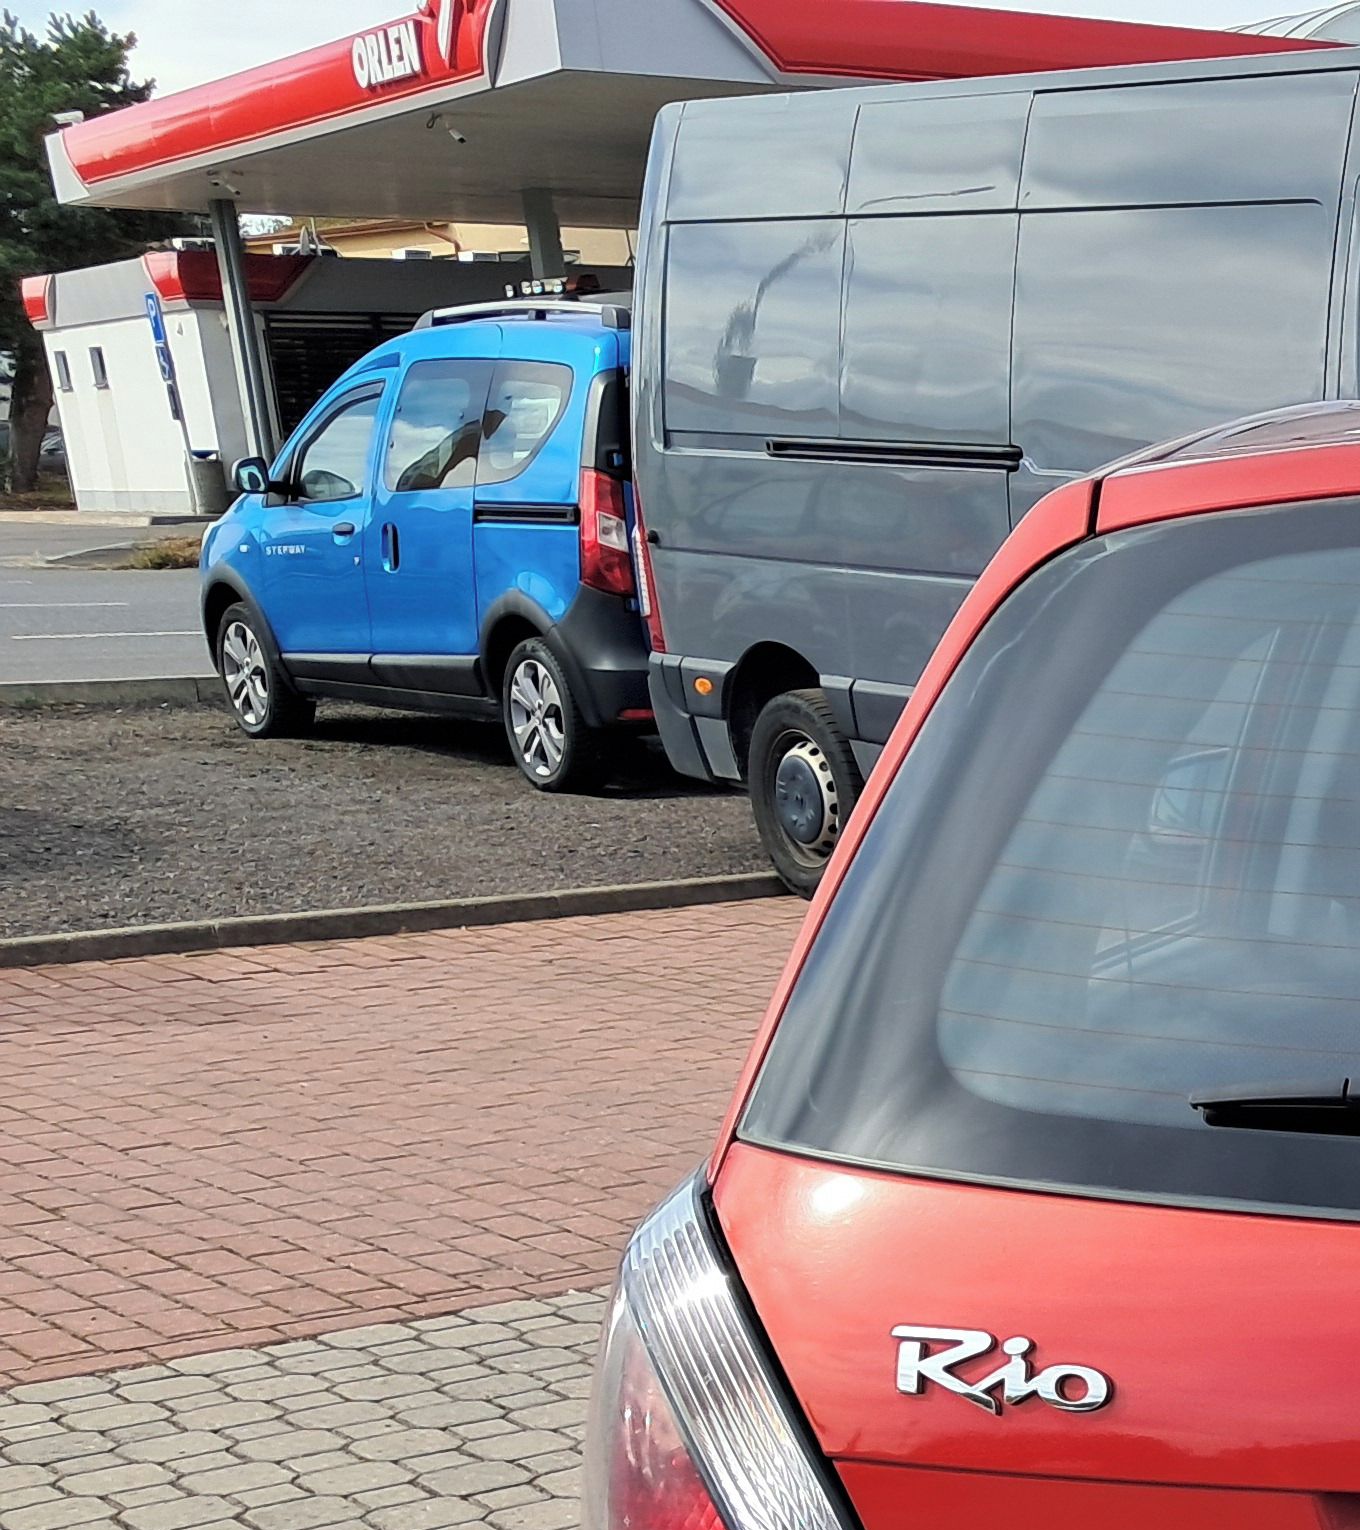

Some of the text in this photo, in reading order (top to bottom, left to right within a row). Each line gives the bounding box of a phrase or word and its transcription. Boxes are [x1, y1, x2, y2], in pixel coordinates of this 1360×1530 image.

[352, 20, 421, 89] ORLEN
[265, 544, 306, 556] STEPWAY
[890, 1323, 1114, 1416] Rio
